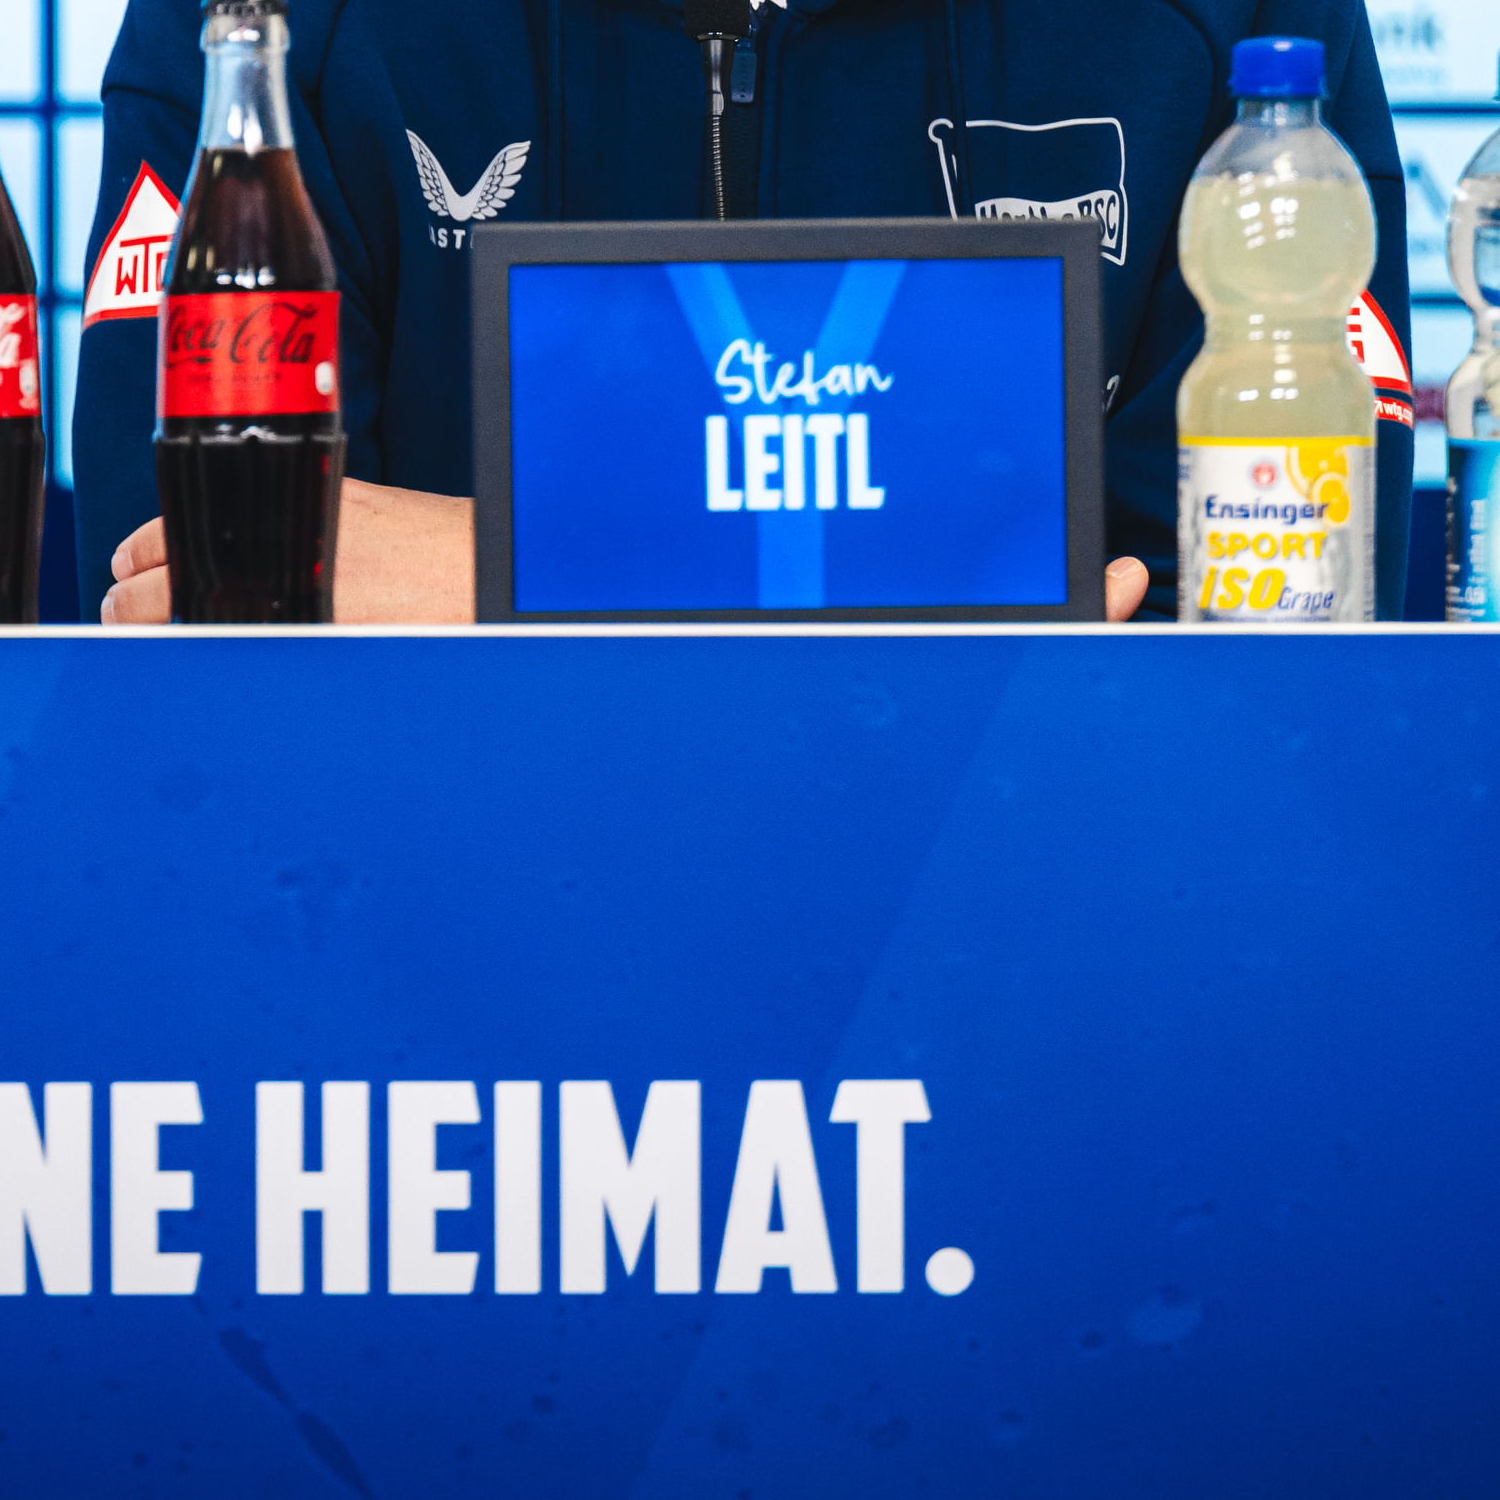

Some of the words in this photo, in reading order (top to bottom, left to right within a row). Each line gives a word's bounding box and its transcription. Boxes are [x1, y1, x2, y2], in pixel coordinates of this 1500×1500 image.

[715, 339, 894, 404] Stefan
[706, 414, 886, 511] LEITL
[1205, 494, 1330, 526] Ensinger
[1207, 531, 1327, 560] SPORT
[1277, 585, 1335, 614] Grape
[254, 1079, 976, 1296] HEIMAT.
